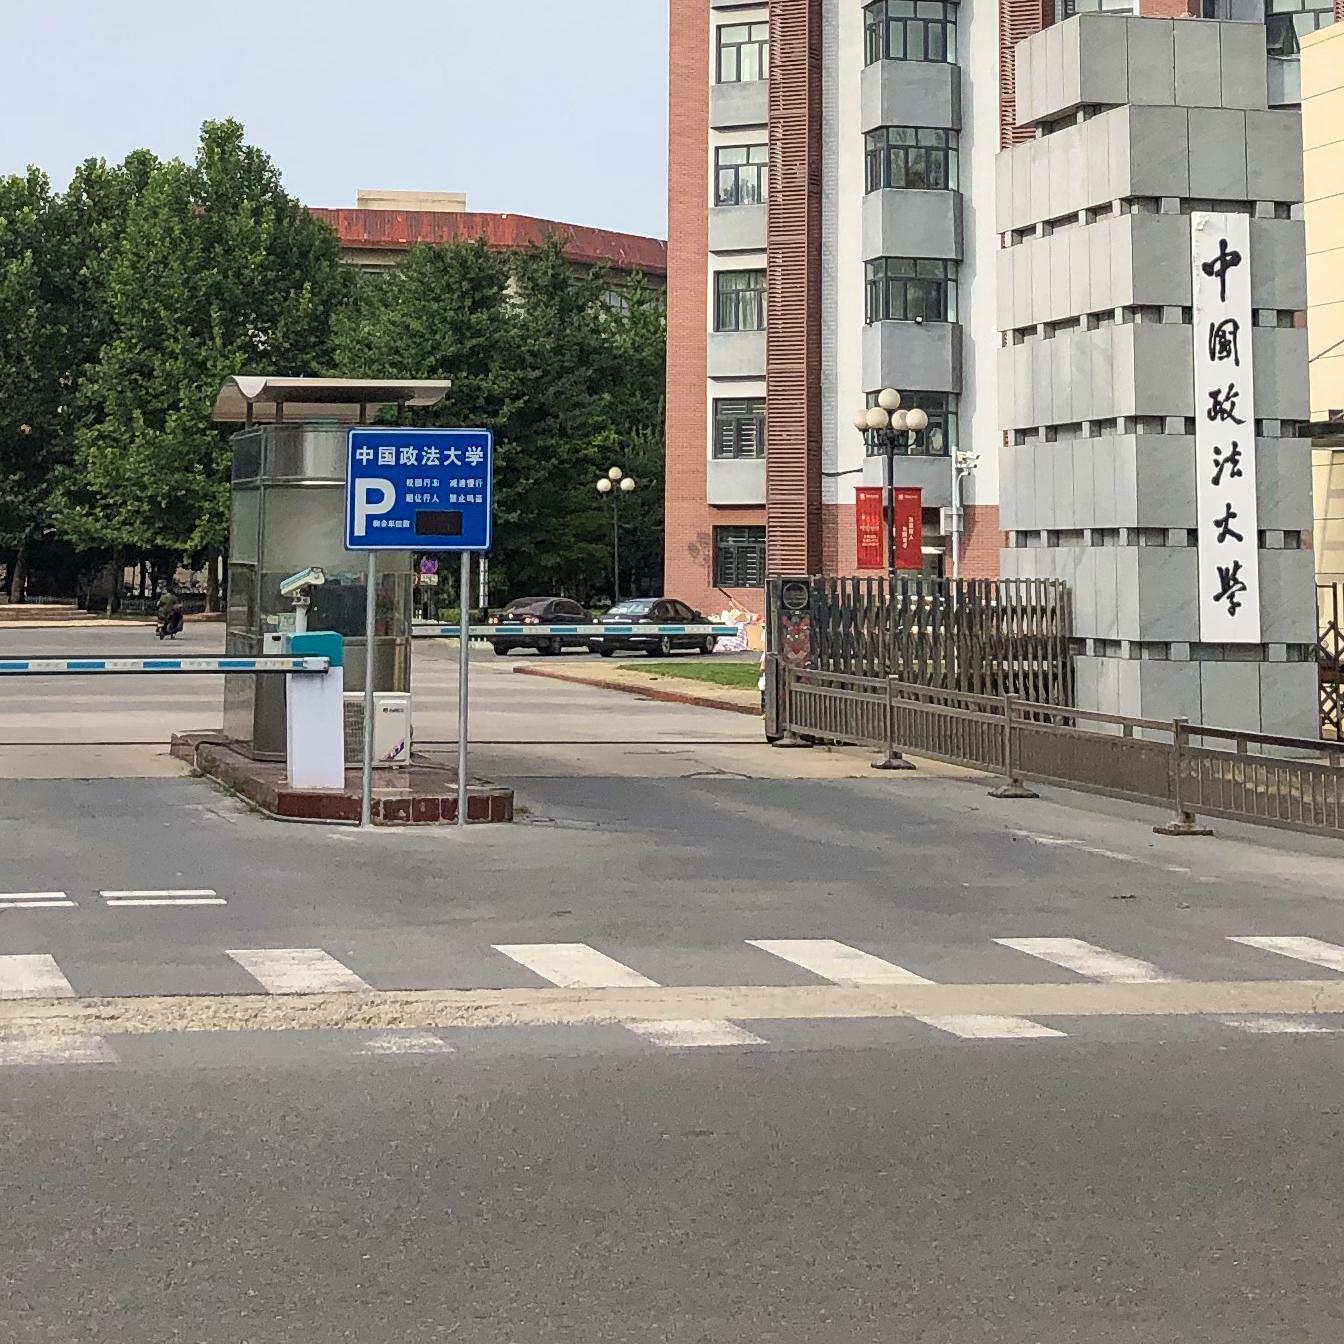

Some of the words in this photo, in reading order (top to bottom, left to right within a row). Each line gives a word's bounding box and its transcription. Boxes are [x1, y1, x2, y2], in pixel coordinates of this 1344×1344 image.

[356, 445, 484, 466] 中国政法大学
[354, 478, 396, 536] P
